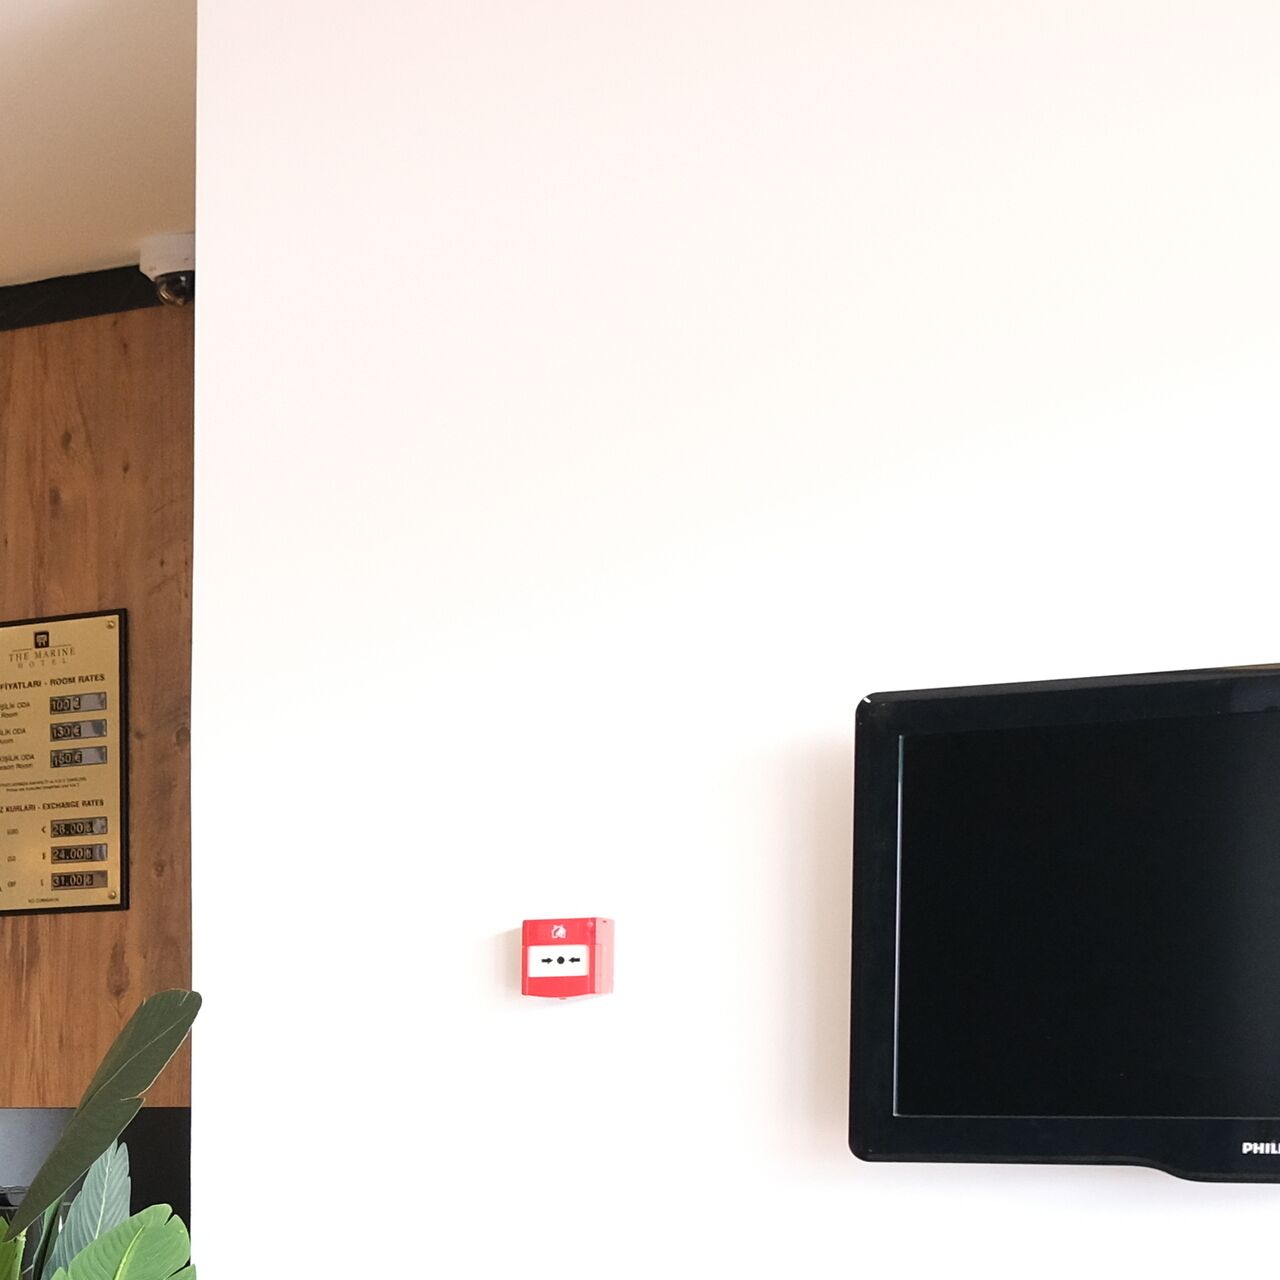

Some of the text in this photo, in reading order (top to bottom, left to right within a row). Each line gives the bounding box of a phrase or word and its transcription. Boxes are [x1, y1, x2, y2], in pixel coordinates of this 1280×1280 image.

[8, 647, 77, 662] THE MARINE
[49, 677, 76, 687] ROOM
[78, 673, 105, 683] RATES
[52, 698, 70, 710] 100
[42, 801, 80, 810] EXCHANGE
[81, 799, 104, 807] RATES
